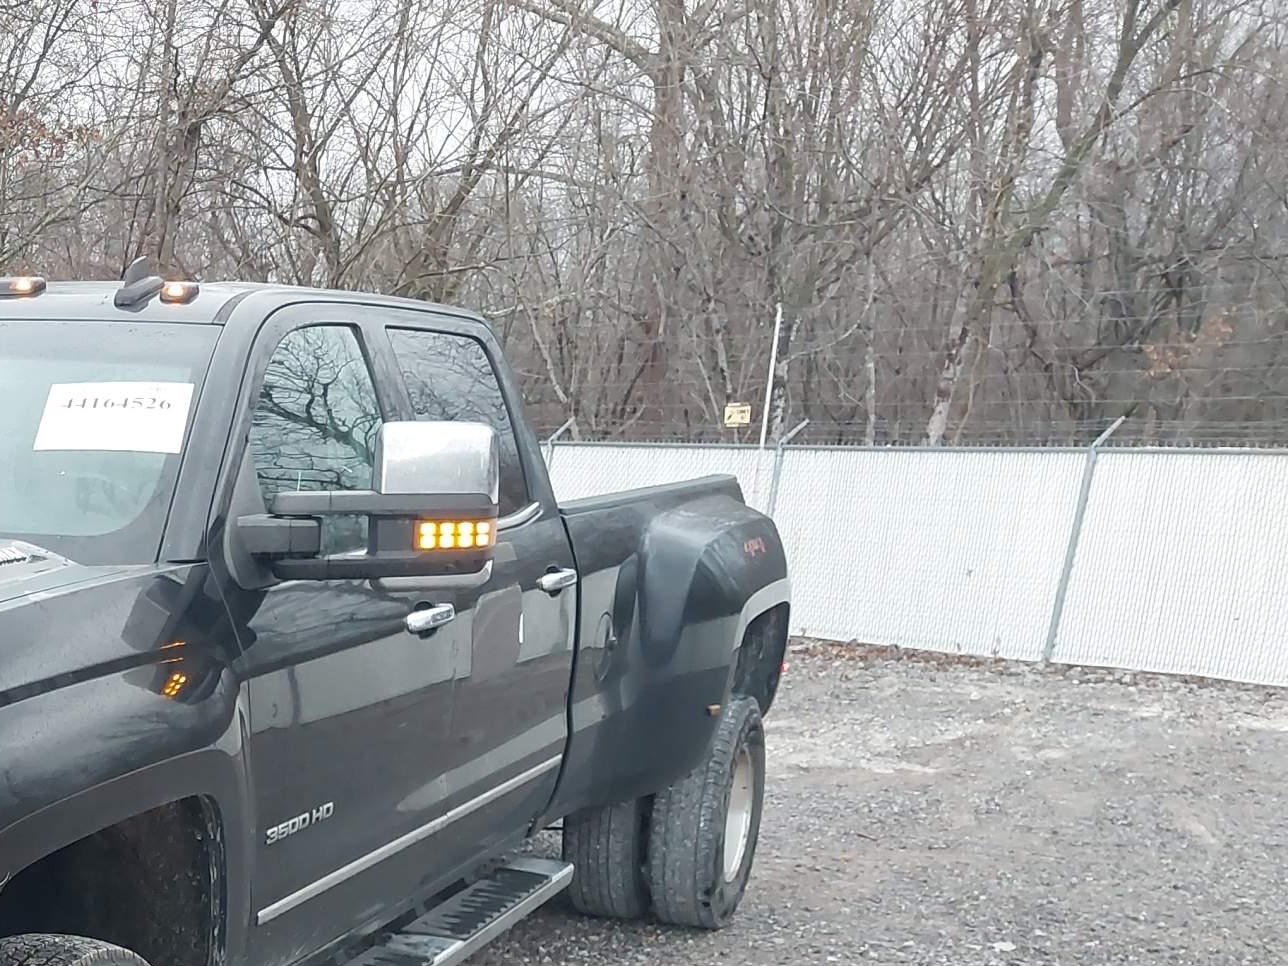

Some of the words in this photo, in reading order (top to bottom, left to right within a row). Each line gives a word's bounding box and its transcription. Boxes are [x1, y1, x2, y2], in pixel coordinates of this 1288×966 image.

[62, 396, 173, 410] 44164526
[265, 812, 311, 845] 3500
[311, 801, 334, 825] HD
